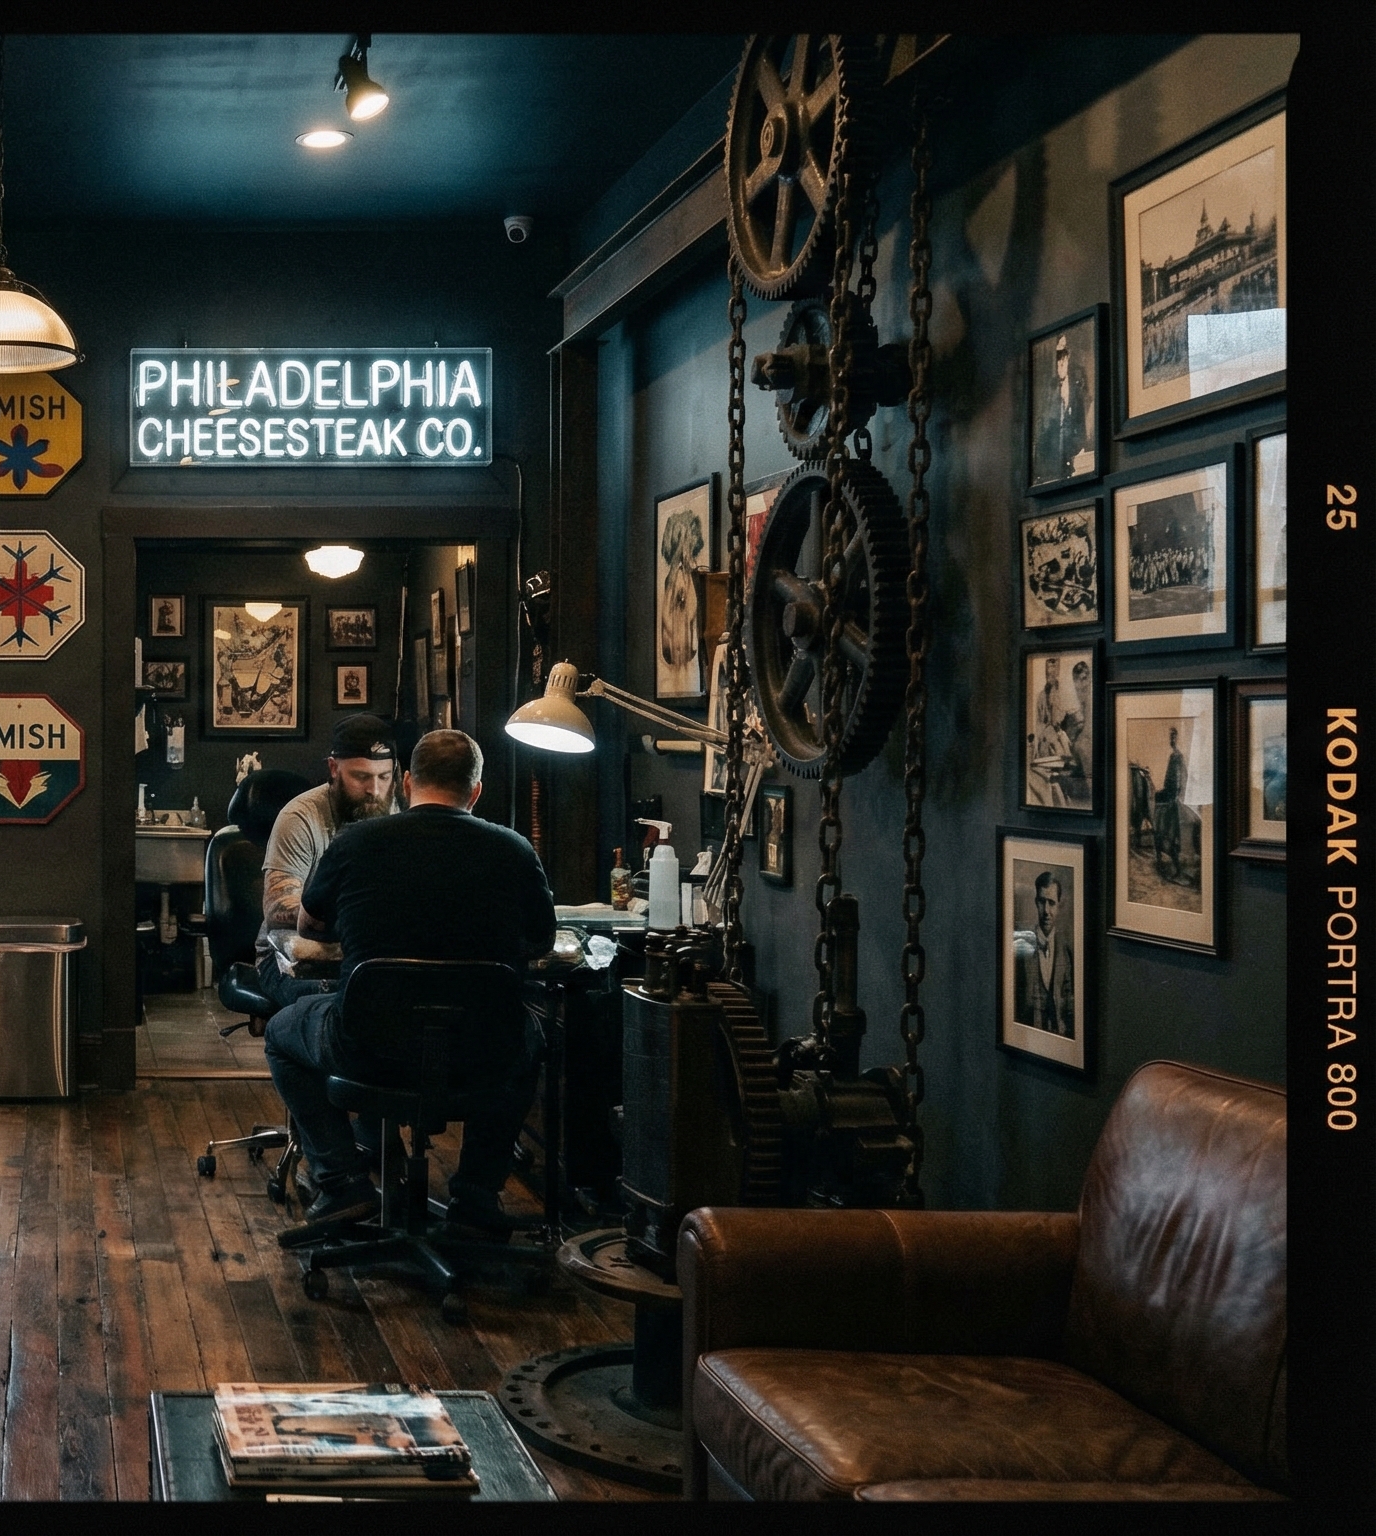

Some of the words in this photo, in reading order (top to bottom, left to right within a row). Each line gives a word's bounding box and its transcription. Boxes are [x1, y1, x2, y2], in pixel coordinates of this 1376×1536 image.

[137, 358, 482, 408] PHILADELPHIA
[137, 416, 408, 458] CHEESESTEAK
[418, 416, 483, 458] CO.
